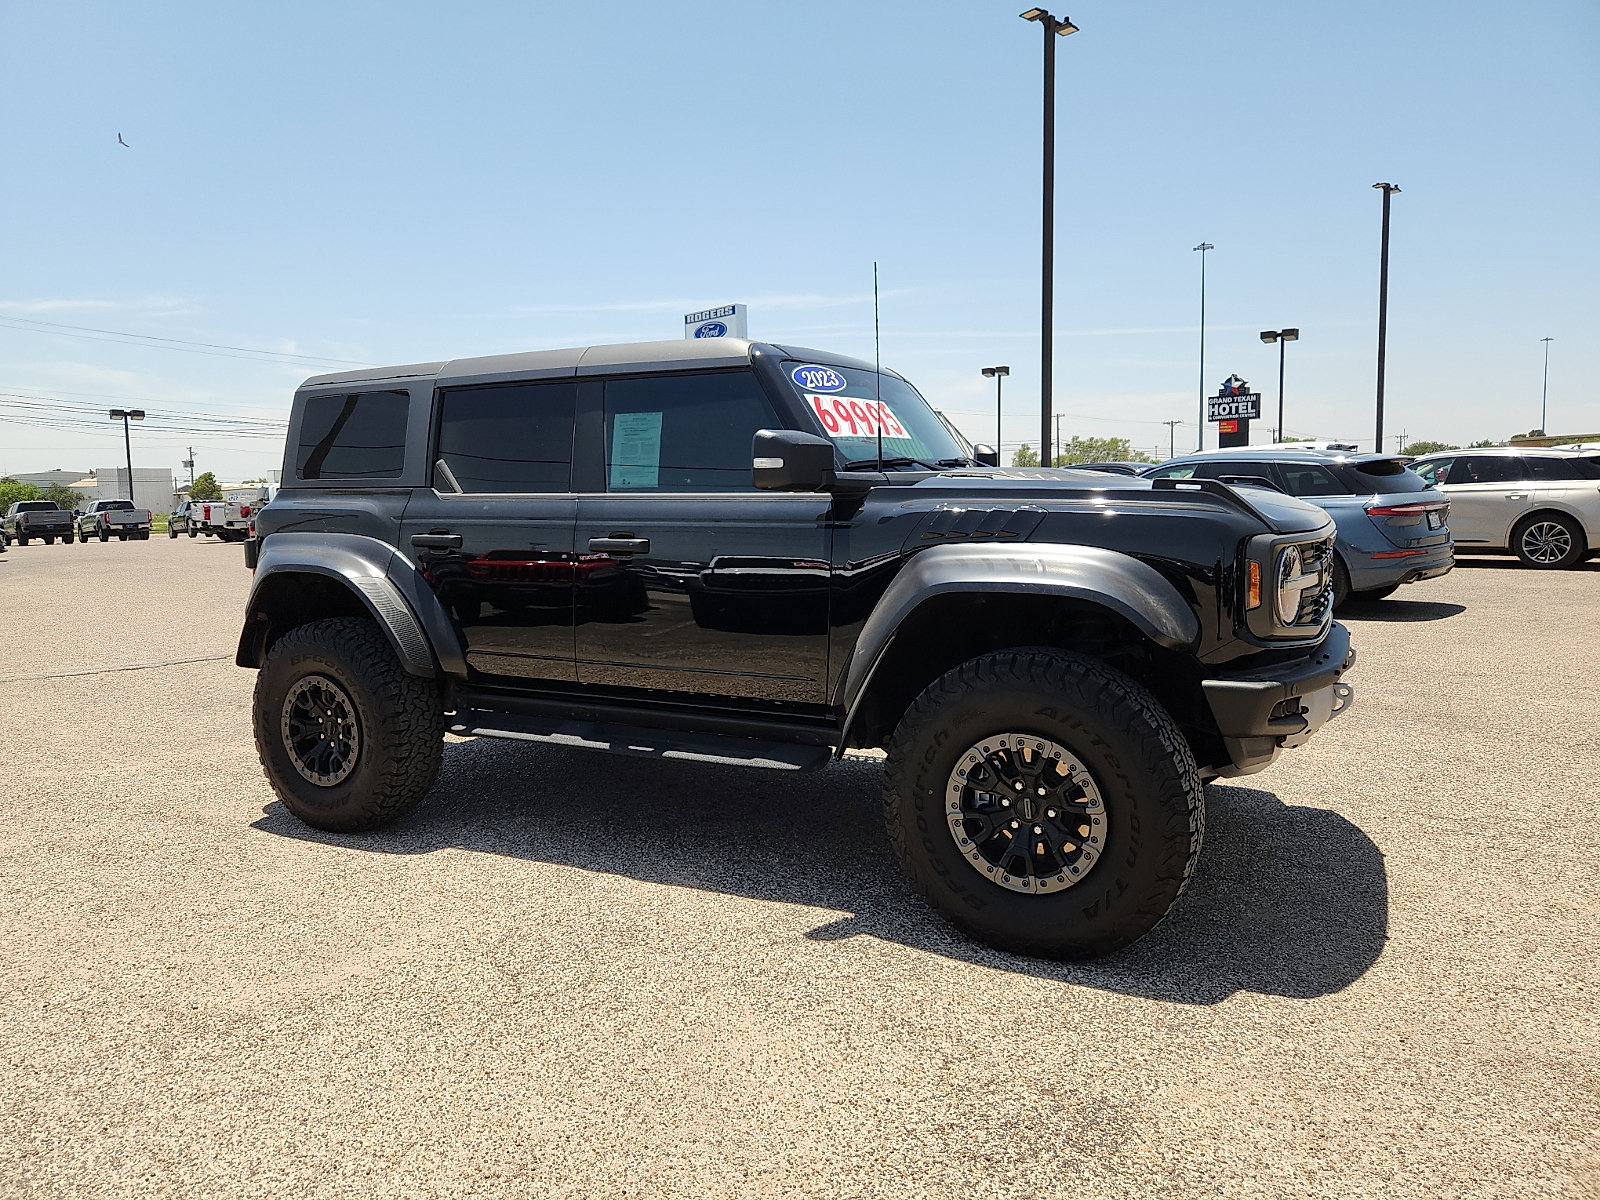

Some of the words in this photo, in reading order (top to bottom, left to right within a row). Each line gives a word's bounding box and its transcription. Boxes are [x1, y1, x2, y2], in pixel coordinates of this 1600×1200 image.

[686, 306, 733, 324] ROGERS
[699, 325, 720, 339] Ford
[801, 370, 840, 388] 2023
[813, 396, 903, 436] 69995
[1208, 402, 1256, 415] HOTEL
[1035, 706, 1142, 868] All-Terrain
[912, 729, 987, 911] BFGoodrich
[1081, 876, 1129, 921] T/A
